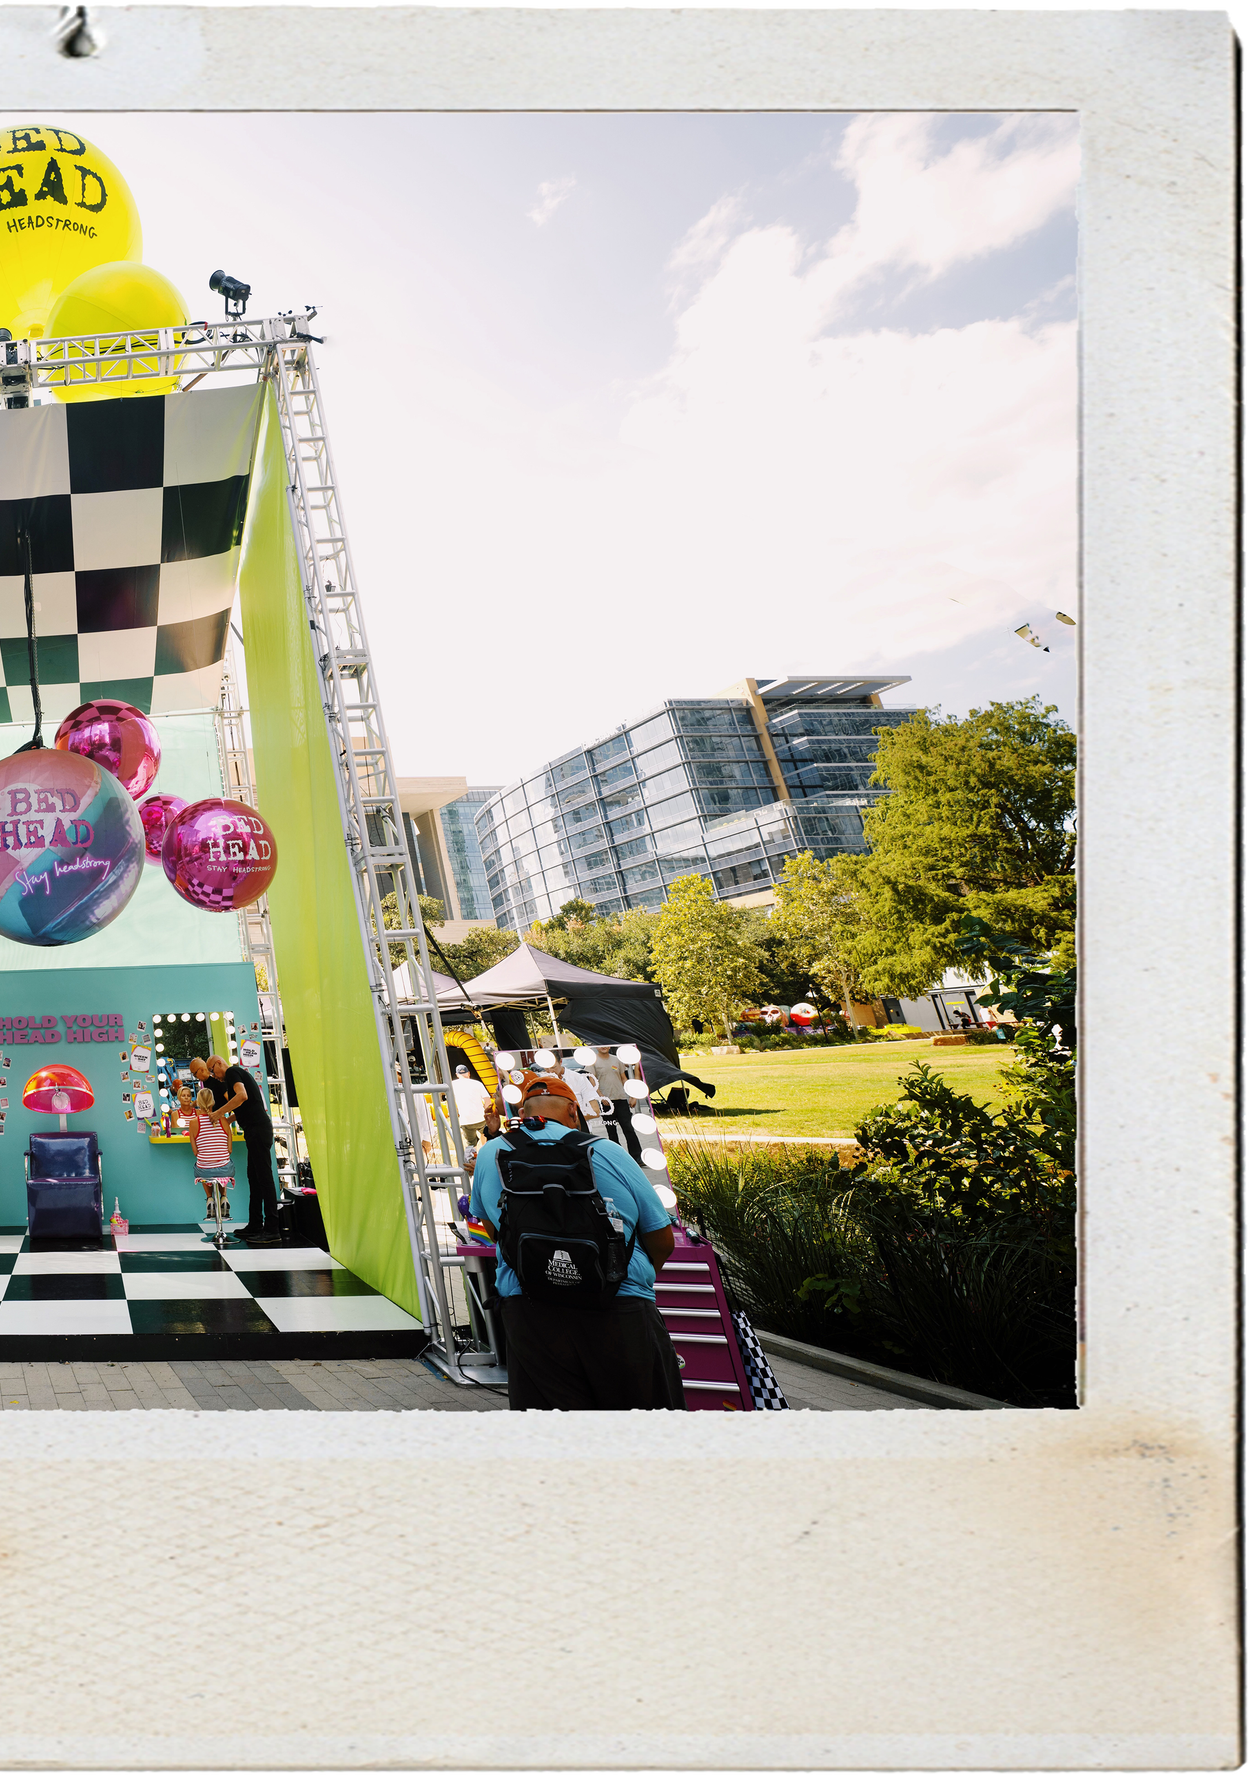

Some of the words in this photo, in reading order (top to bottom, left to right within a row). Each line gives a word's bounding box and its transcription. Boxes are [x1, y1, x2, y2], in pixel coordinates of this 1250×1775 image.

[6, 215, 98, 239] HEADSTRONG
[6, 787, 81, 817] BED
[211, 815, 264, 836] BED
[206, 838, 271, 862] HEAD
[15, 871, 50, 895] Stay
[54, 857, 111, 880] headstrong
[206, 864, 228, 873] STAY
[233, 865, 271, 873] HEADSTRONG
[61, 1013, 124, 1028] YOUR
[66, 1028, 125, 1043] HIGH
[548, 1259, 578, 1270] MEDICAL
